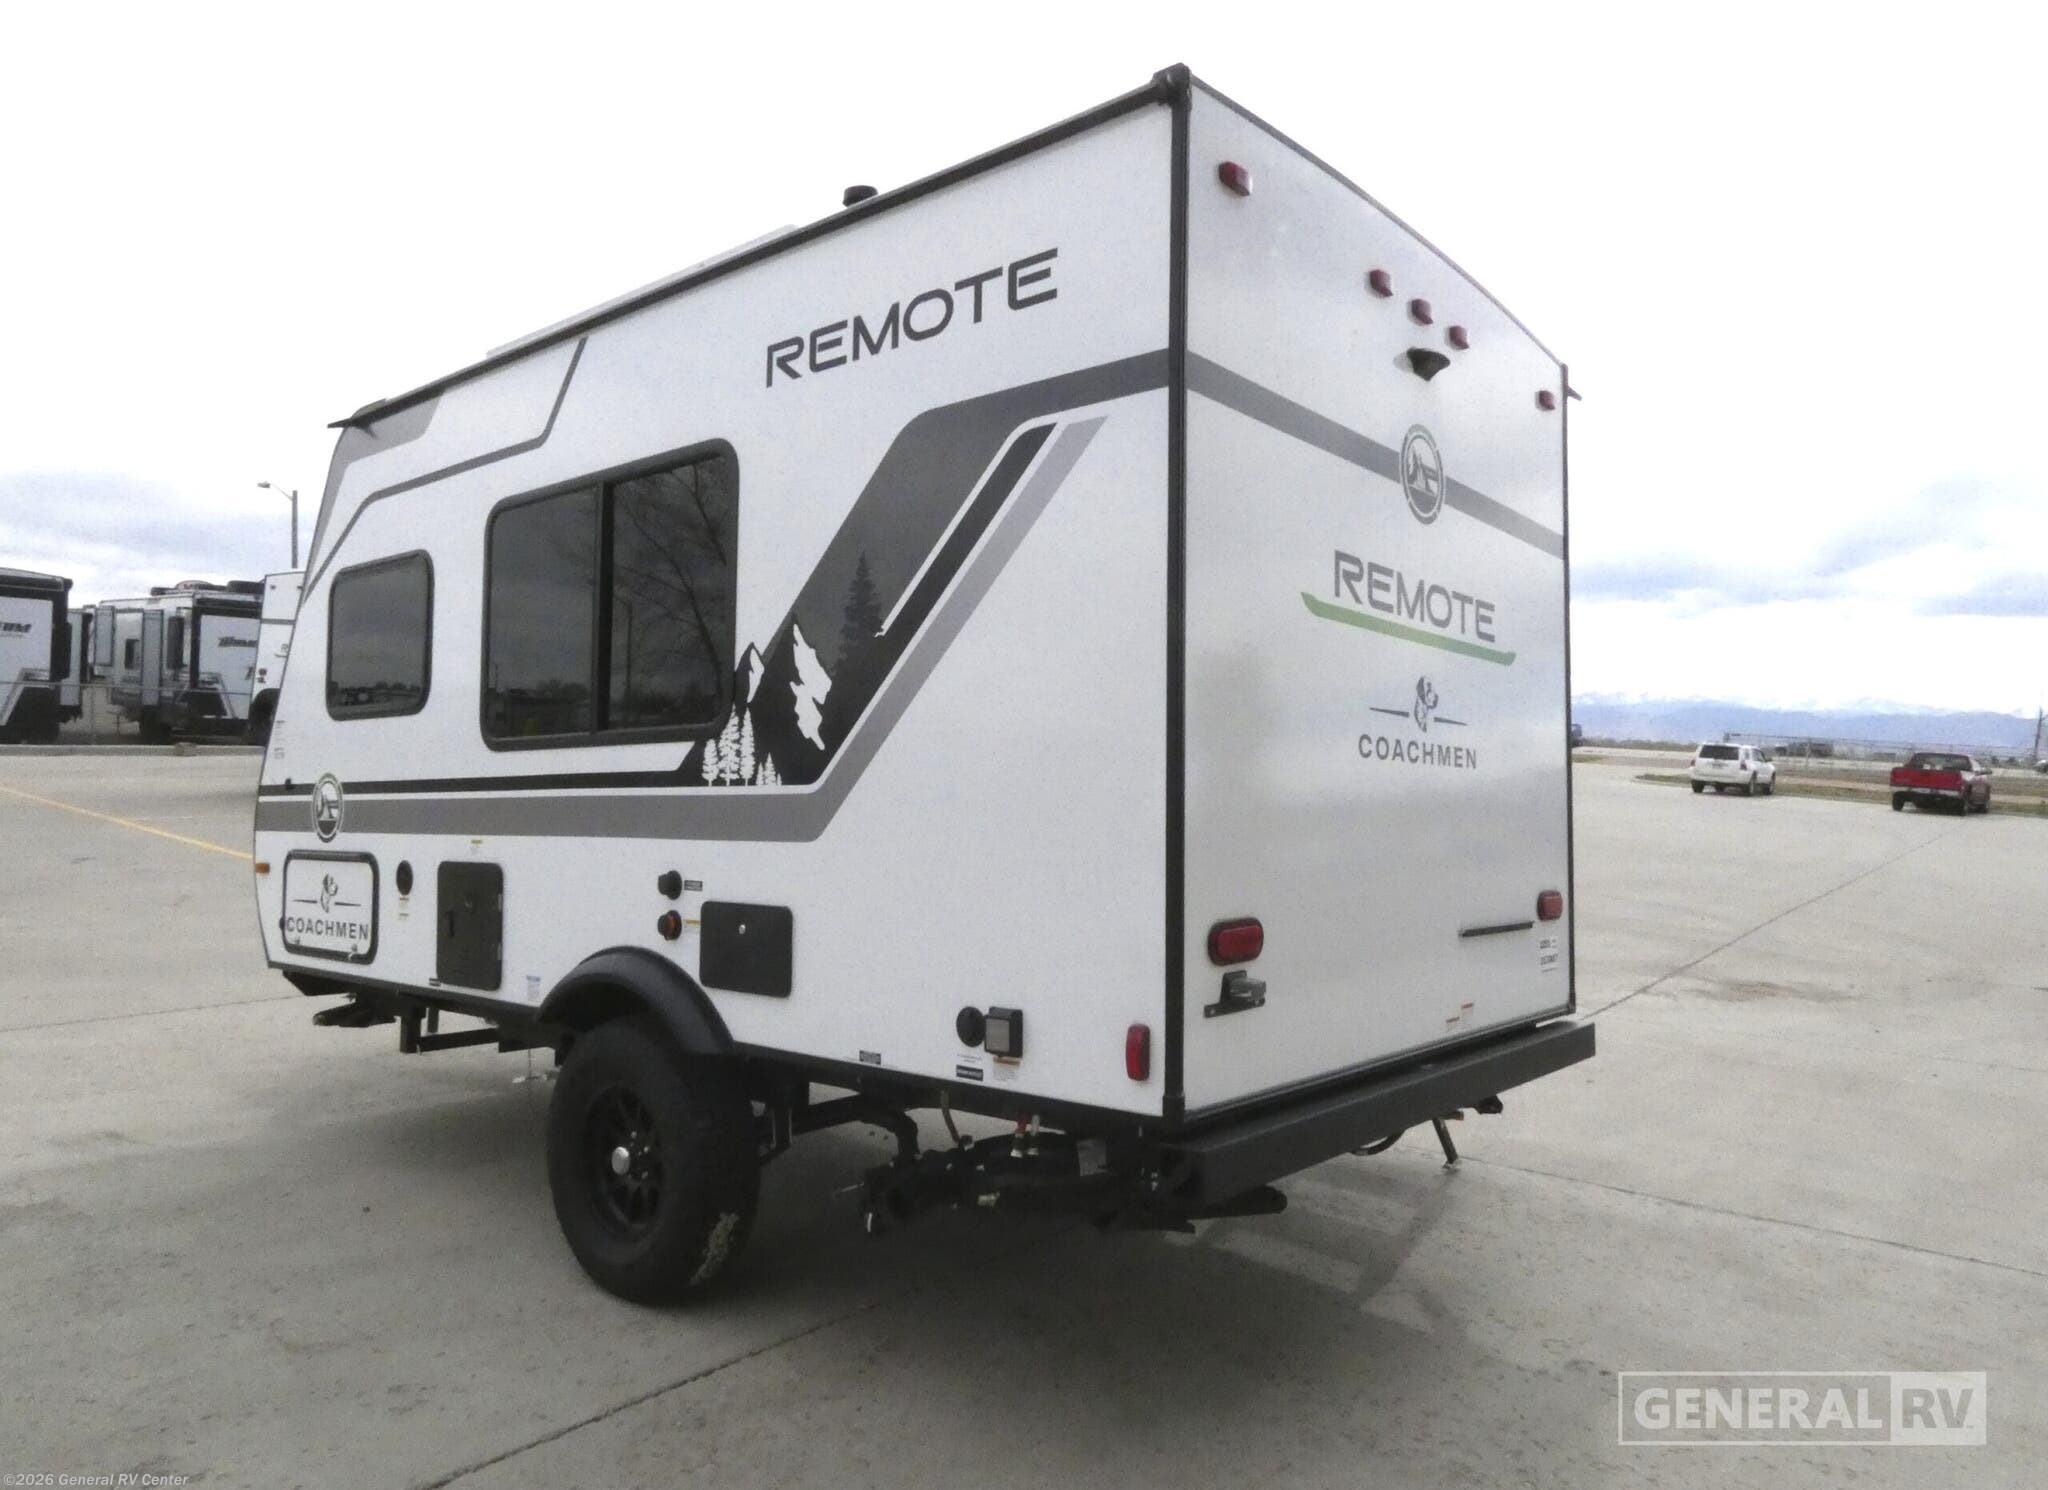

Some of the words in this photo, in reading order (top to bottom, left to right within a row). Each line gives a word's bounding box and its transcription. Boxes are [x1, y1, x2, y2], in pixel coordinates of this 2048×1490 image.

[766, 247, 1058, 388] REMOTE
[1334, 549, 1496, 643] REMOTE
[1358, 733, 1477, 770] COACHMEN
[286, 916, 369, 940] COACHMEN
